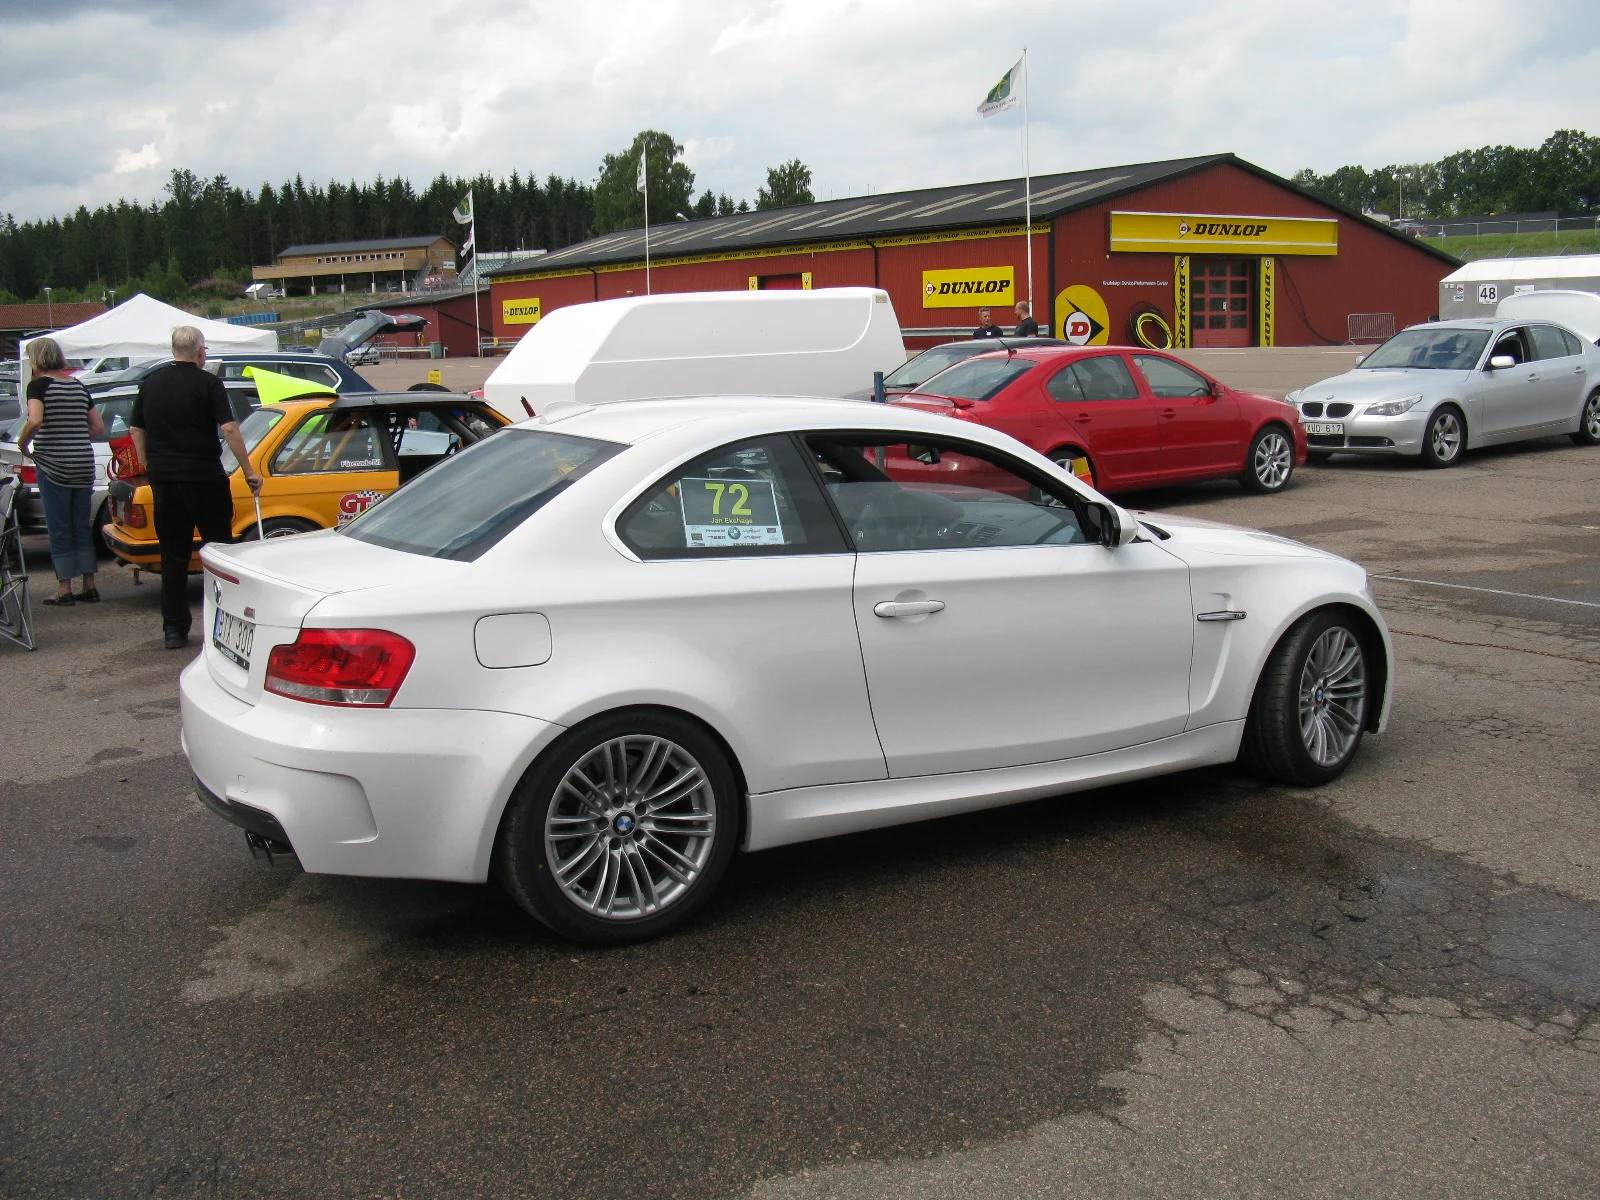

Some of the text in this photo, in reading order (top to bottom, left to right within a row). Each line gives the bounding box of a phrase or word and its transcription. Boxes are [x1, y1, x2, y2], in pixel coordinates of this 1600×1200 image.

[1193, 223, 1267, 236] DUNLOP
[939, 279, 1011, 295] DUNLOP
[1479, 287, 1496, 300] 48
[509, 306, 539, 316] DUNLOP
[1325, 424, 1342, 433] 617
[340, 493, 372, 514] GT
[704, 483, 752, 516] 72
[235, 621, 254, 657] 300
